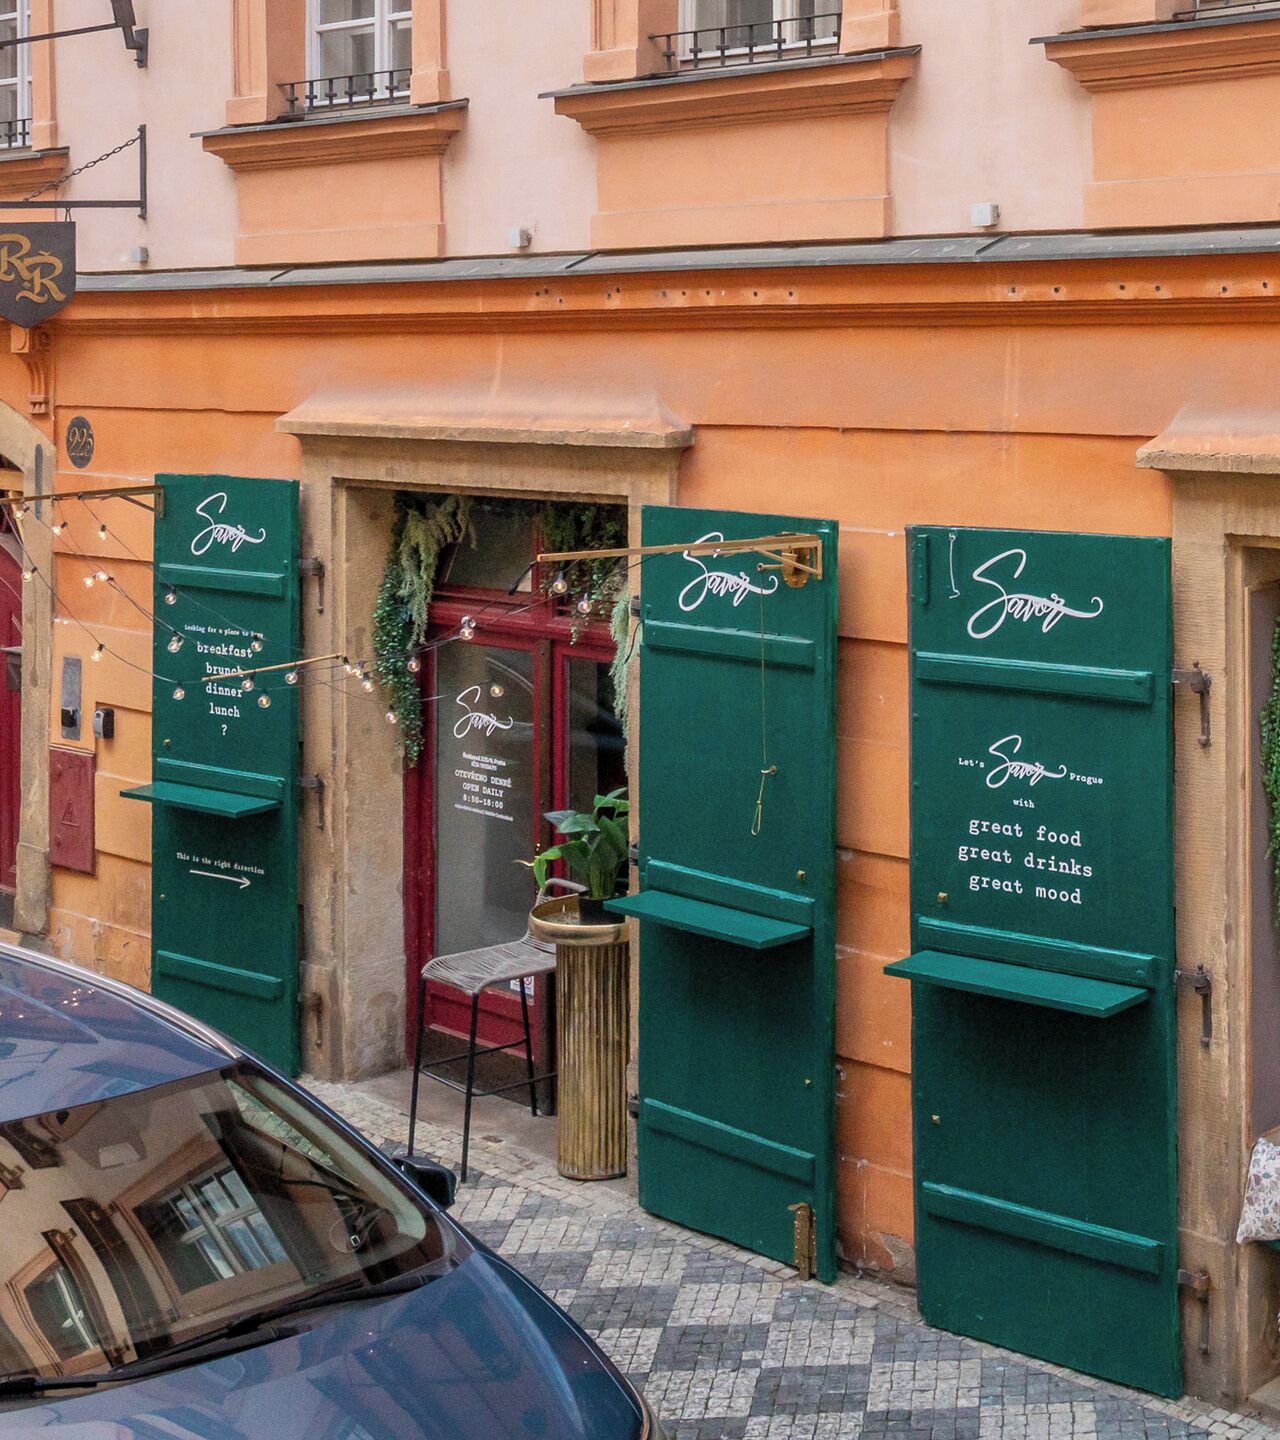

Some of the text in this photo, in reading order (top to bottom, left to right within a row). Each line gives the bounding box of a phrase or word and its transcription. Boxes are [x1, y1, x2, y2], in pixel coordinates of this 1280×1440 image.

[191, 491, 266, 555] Savor
[967, 548, 1103, 639] Savor
[197, 641, 253, 658] breakfast
[205, 662, 244, 677] brunch
[205, 682, 244, 698] dinner
[209, 702, 240, 718] lunch
[221, 723, 228, 736] ?
[958, 734, 1104, 789] Let's Savor Prague
[462, 782, 504, 797] OPEN DAILY
[1012, 797, 1035, 808] with
[969, 819, 1082, 847] great food
[176, 852, 190, 861] This
[192, 855, 199, 863] is
[201, 857, 211, 865] the
[214, 860, 231, 869] right
[958, 845, 1093, 877] great drinks
[969, 875, 1082, 904] great mood
